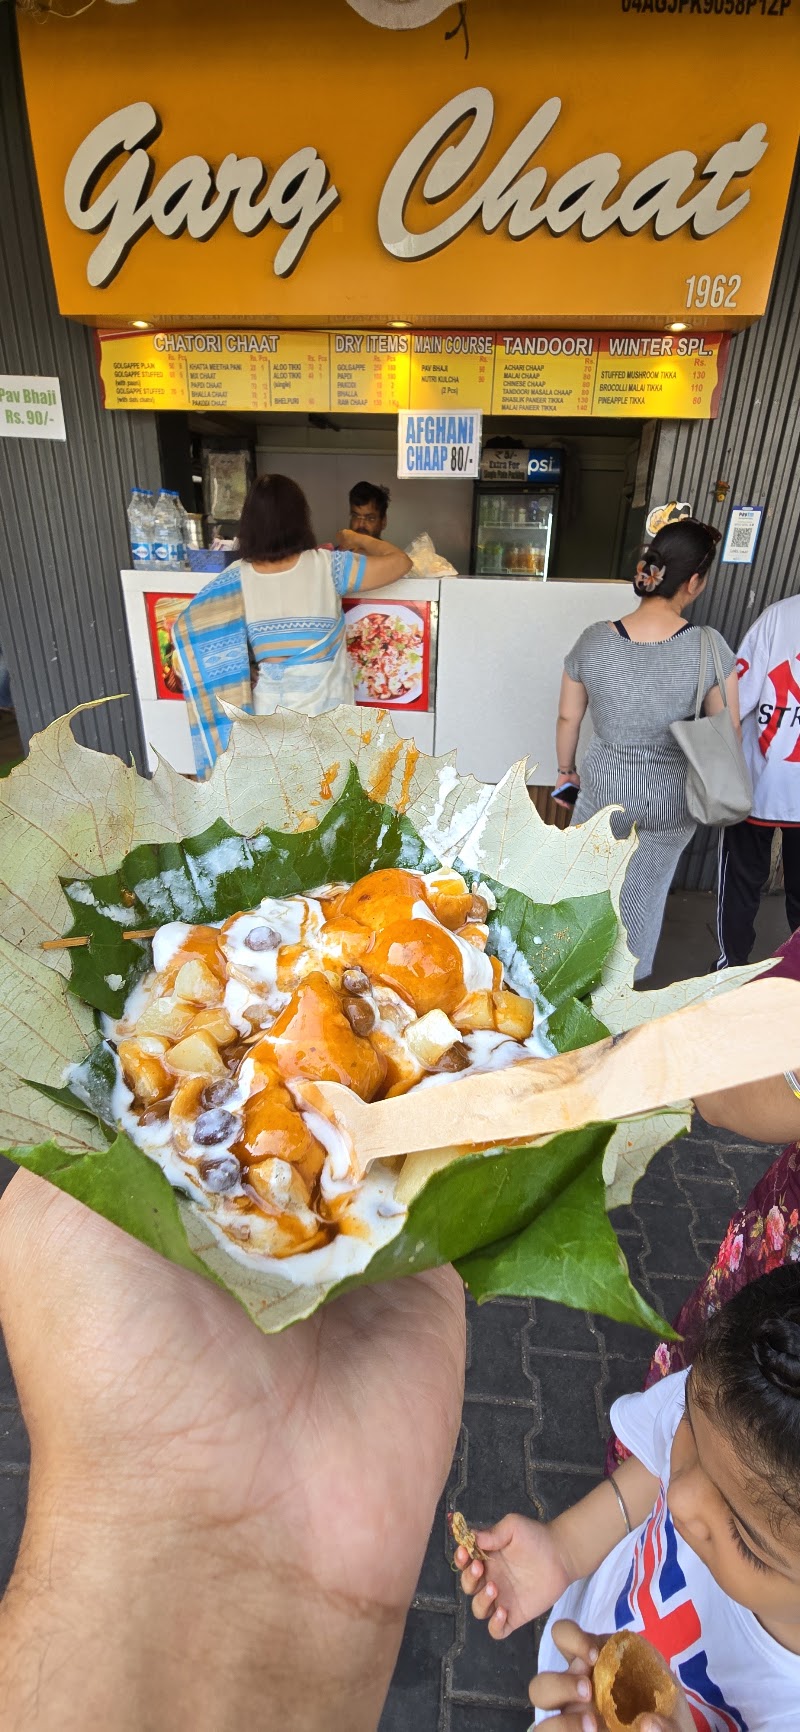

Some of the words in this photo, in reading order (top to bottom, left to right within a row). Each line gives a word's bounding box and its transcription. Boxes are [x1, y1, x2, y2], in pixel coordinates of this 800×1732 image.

[64, 101, 339, 287] Garg
[377, 87, 769, 258] Chaat
[685, 274, 742, 308] 1962
[153, 333, 222, 352] CHATORI
[225, 334, 279, 352] CHAAT
[335, 334, 363, 353] DRY
[366, 334, 408, 353] ITEMS
[414, 335, 442, 354] MAIN
[445, 336, 493, 354] COURSE
[503, 336, 593, 356] TANDOORI
[609, 337, 673, 356] WINTER
[676, 337, 713, 357] SPL.
[432, 364, 449, 372] BHAJI
[694, 358, 706, 367] Rs.
[601, 371, 626, 379] STUFFED
[626, 371, 659, 379] MUSHROOM
[660, 371, 677, 379] TIKKA
[692, 371, 706, 379] 130
[0, 388, 20, 403] Pav
[23, 389, 57, 406] Bhaji
[599, 384, 627, 392] BROCOLLI
[628, 384, 645, 392] MALAI
[646, 384, 663, 392] TIKKA
[691, 384, 703, 392] 110
[598, 397, 628, 405] PINEAPPLE
[629, 397, 646, 405] TIKKA
[5, 409, 25, 424] Rs.
[26, 410, 54, 426] 90/-
[405, 416, 474, 444] AFGHANI
[406, 445, 448, 471] CHAAP
[450, 446, 473, 471] 80/-
[508, 461, 520, 469] For
[527, 456, 554, 476] psi
